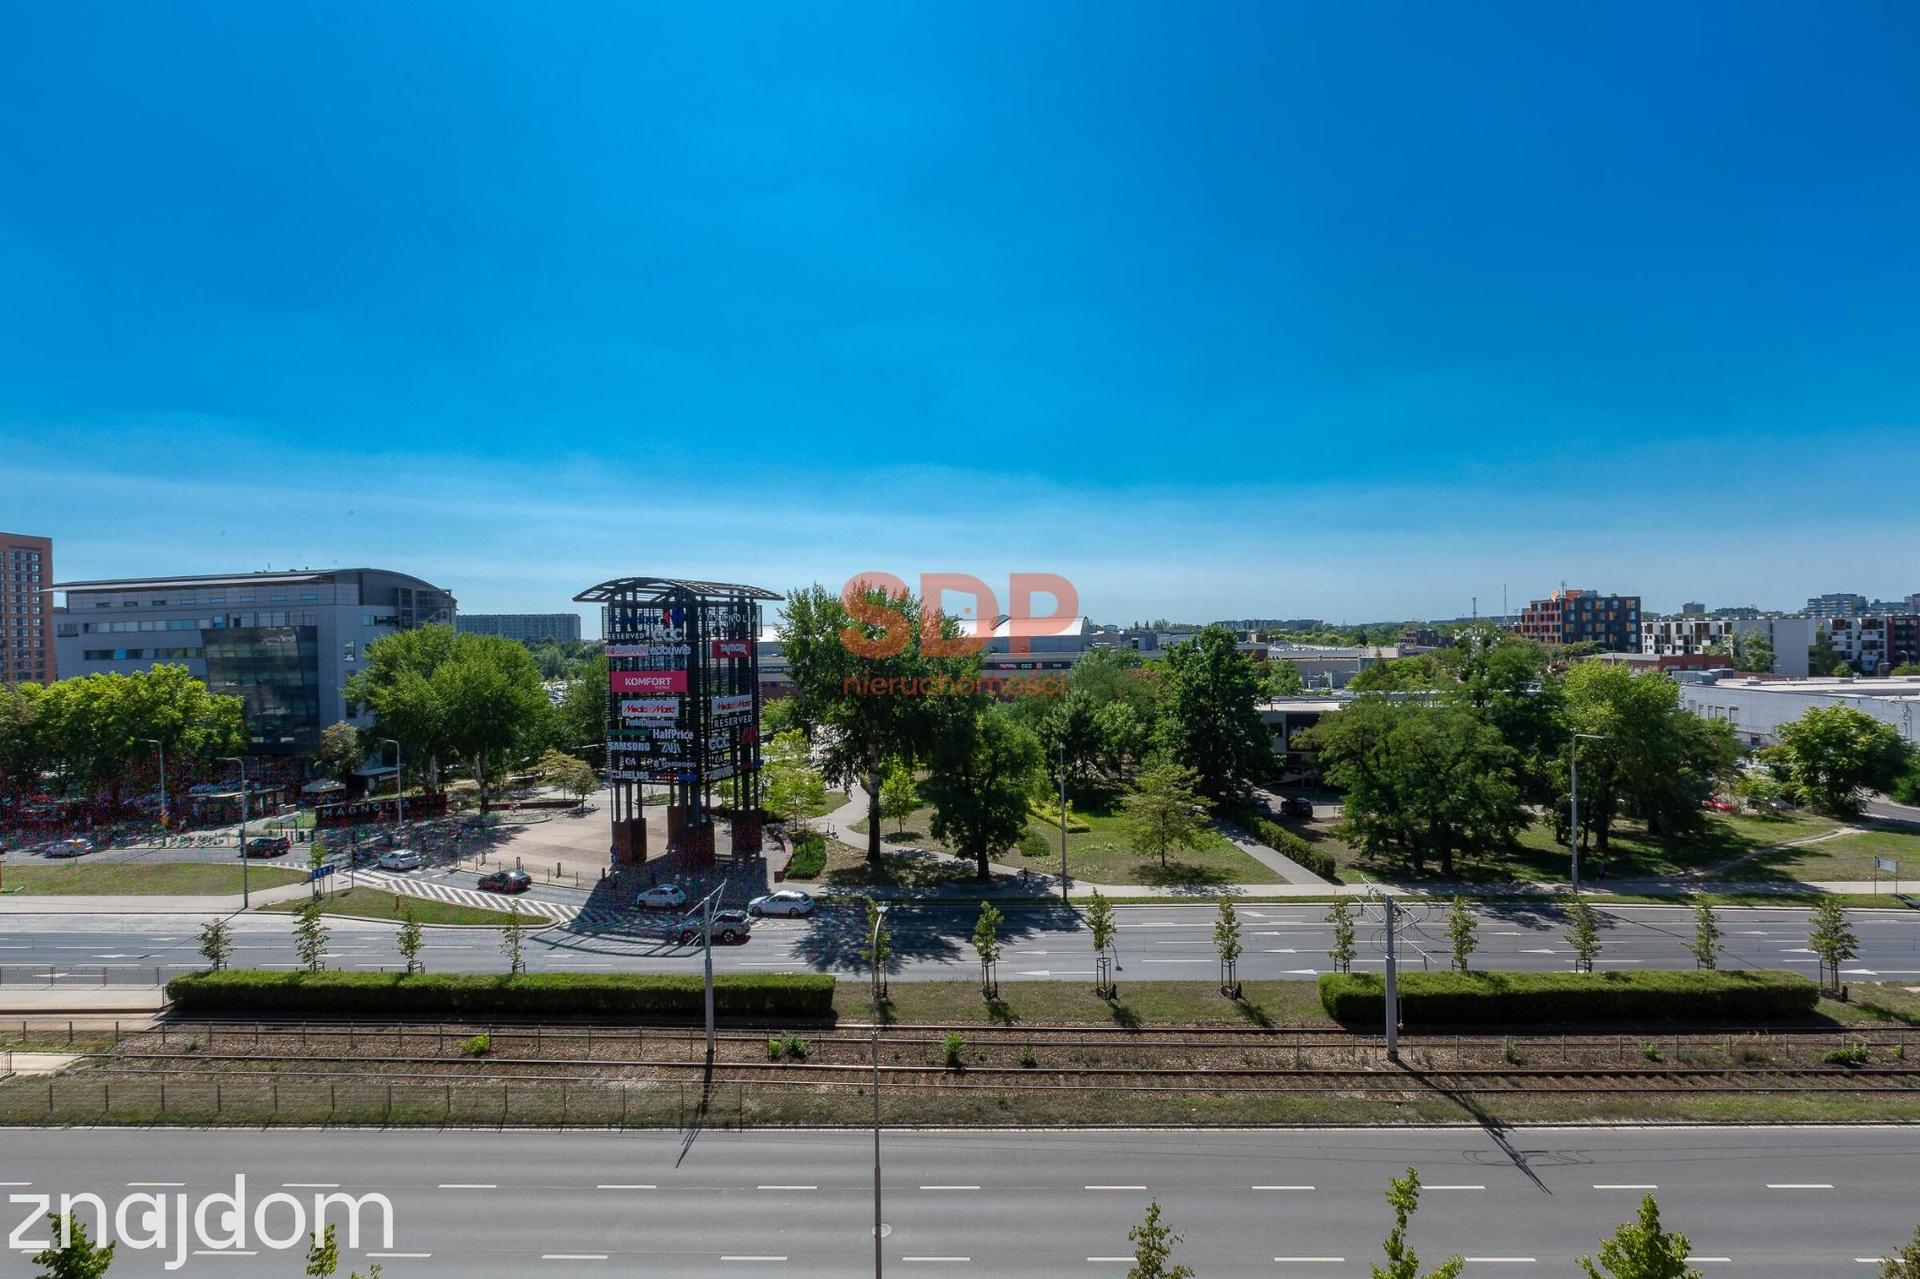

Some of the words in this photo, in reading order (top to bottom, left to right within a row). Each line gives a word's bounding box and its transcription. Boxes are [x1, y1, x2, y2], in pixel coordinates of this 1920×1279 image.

[652, 628, 683, 641] CCC
[625, 677, 672, 686] KOMFORT
[652, 728, 694, 740] HalfPrice
[607, 741, 651, 751] SAMSUNG
